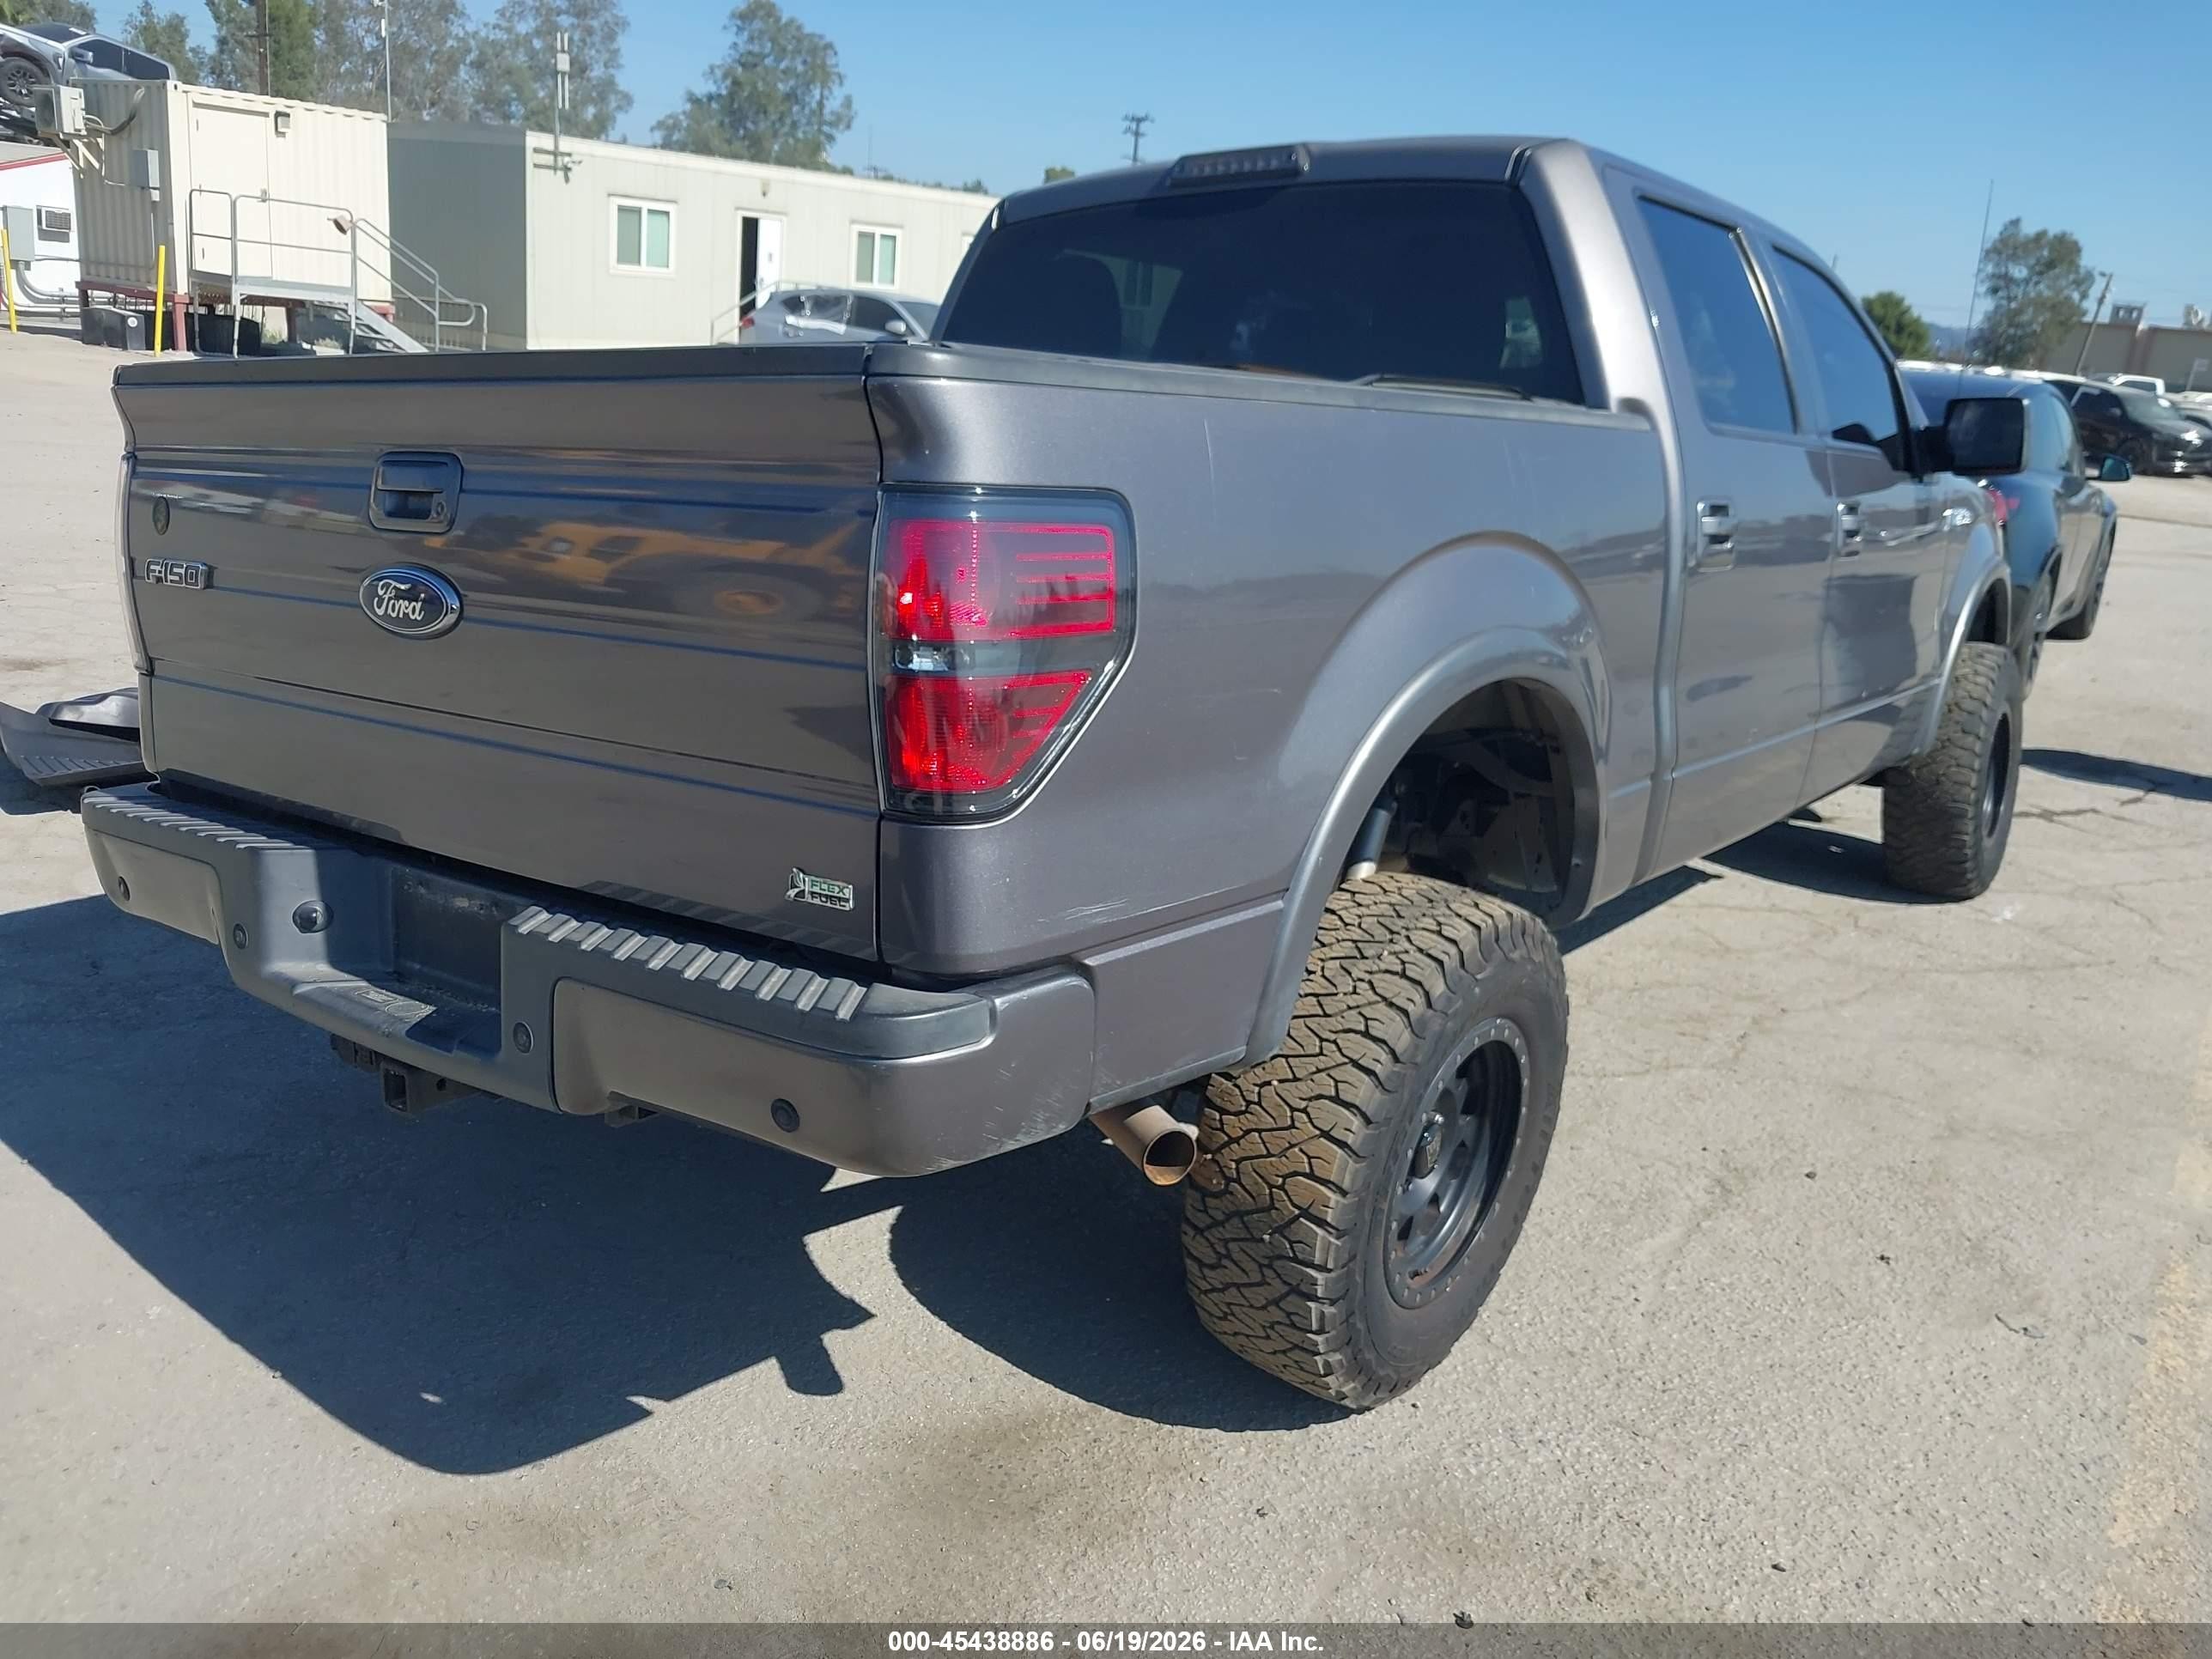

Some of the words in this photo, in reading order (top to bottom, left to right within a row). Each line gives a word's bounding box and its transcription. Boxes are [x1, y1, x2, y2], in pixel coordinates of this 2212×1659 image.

[144, 558, 204, 589] F-150
[373, 579, 426, 621] Ford
[810, 878, 848, 896] FLEX
[810, 892, 848, 908] FUEL
